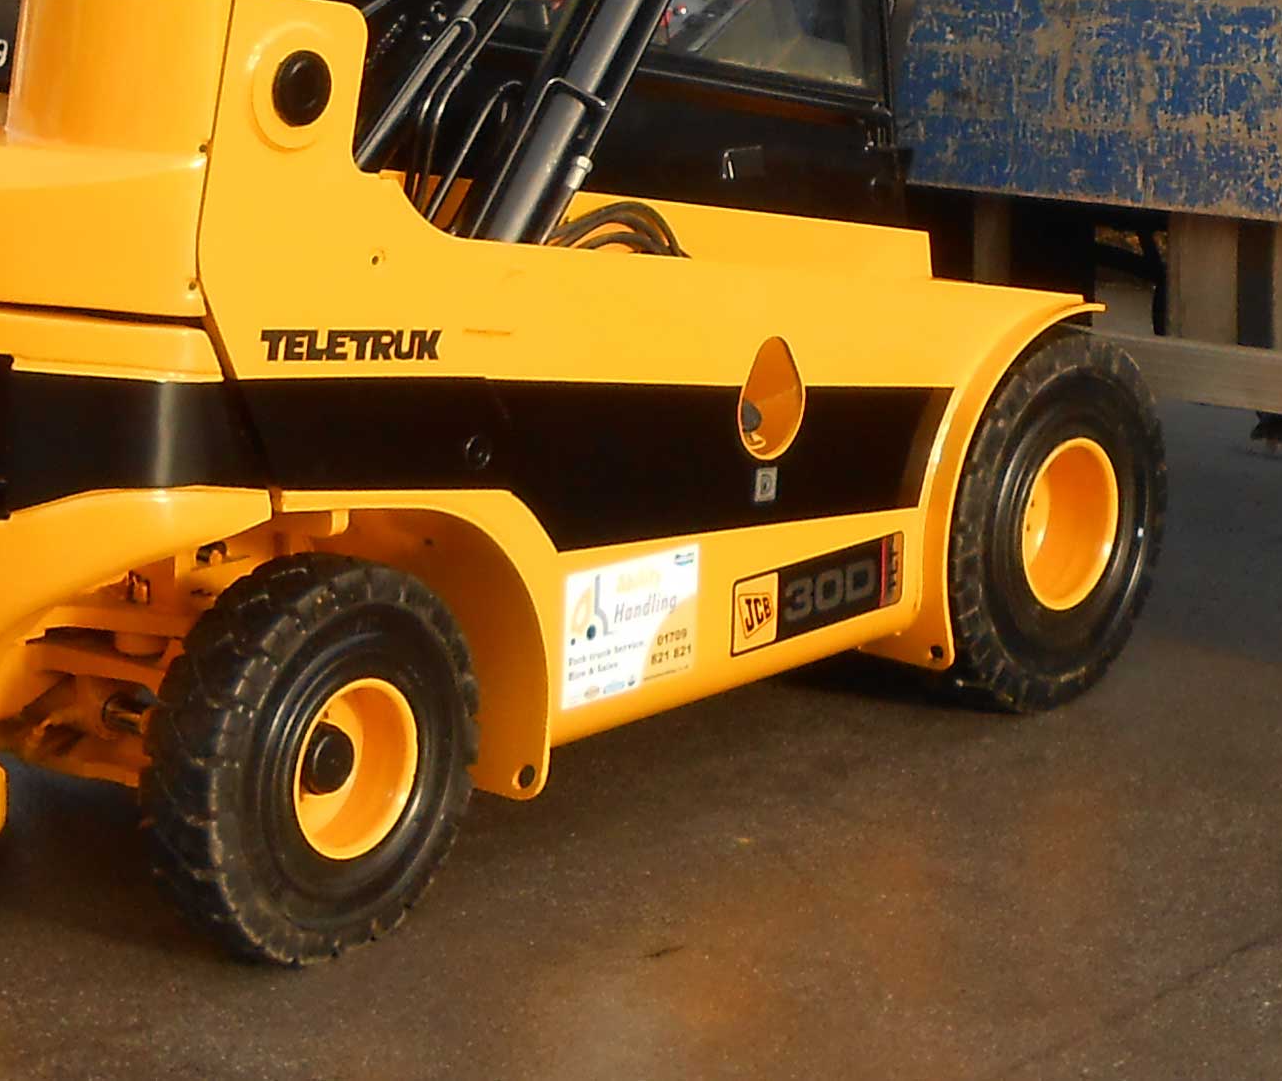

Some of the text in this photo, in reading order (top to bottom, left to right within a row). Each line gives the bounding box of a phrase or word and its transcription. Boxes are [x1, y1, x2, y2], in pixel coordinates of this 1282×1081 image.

[261, 329, 442, 361] TELETRUK
[614, 593, 677, 623] Handling
[745, 597, 771, 633] JCB
